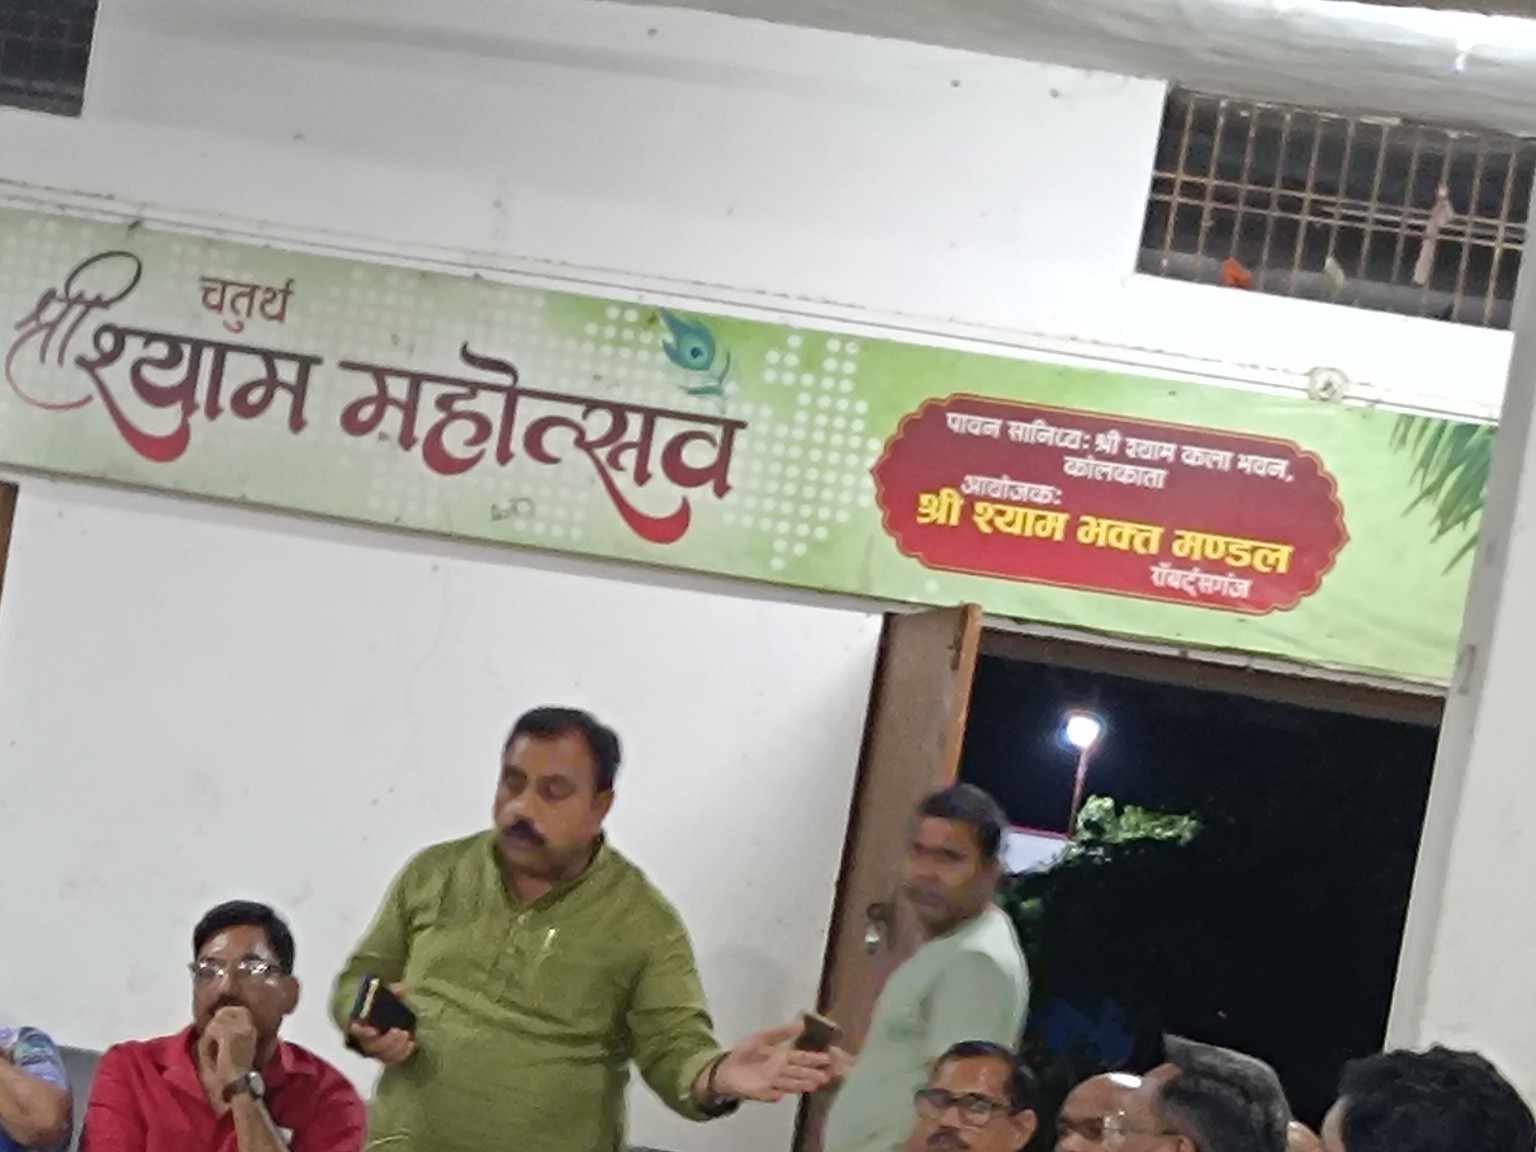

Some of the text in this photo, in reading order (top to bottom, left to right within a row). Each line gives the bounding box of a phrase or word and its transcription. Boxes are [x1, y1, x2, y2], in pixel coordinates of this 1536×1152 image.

[199, 276, 295, 333] चतुर्थ
[5, 250, 747, 544] श्री श्याम महोत्सव
[946, 411, 1001, 440] पावन
[1094, 430, 1120, 456] श्री
[1125, 436, 1175, 463] श्याम
[1180, 445, 1231, 471] कला
[916, 487, 1295, 574] श्री श्याम भक्त मण्डल
